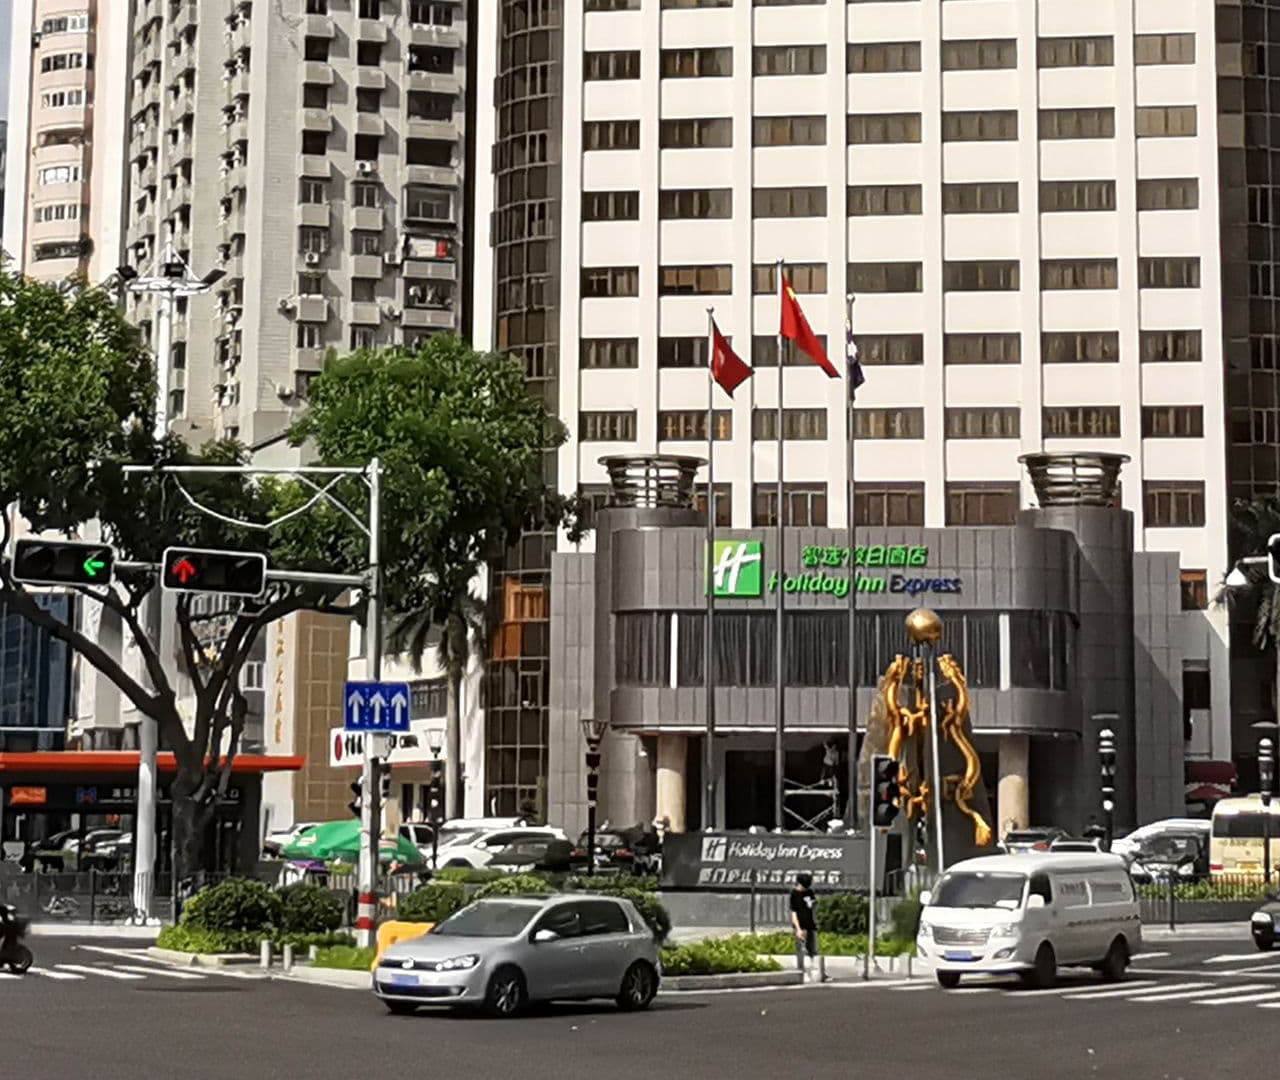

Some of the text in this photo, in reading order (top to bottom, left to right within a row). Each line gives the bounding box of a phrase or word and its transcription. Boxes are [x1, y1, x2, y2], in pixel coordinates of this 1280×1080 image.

[890, 574, 961, 597] Express
[728, 841, 843, 861] Holiday Inn Express
